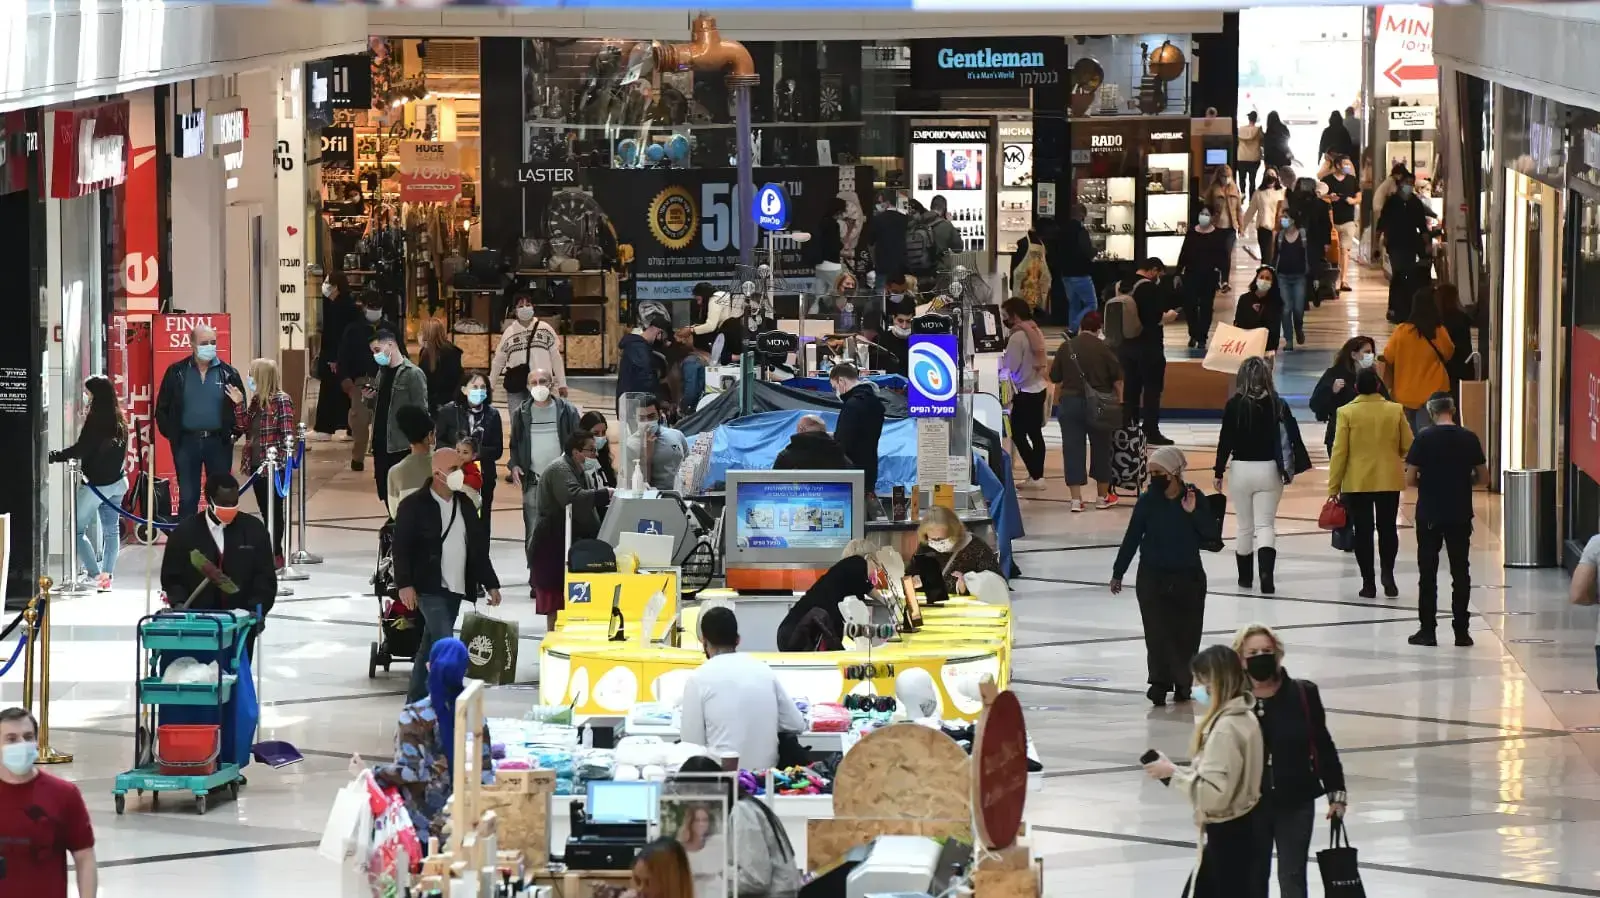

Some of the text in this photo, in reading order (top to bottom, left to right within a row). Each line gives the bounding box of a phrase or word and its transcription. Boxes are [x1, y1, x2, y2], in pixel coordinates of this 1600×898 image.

[938, 48, 1044, 68] Gentleman
[997, 71, 1015, 79] World
[1091, 135, 1123, 147] RADO
[415, 144, 444, 153] HUGE
[518, 168, 574, 182] LASTER
[932, 405, 955, 414] מפעל
